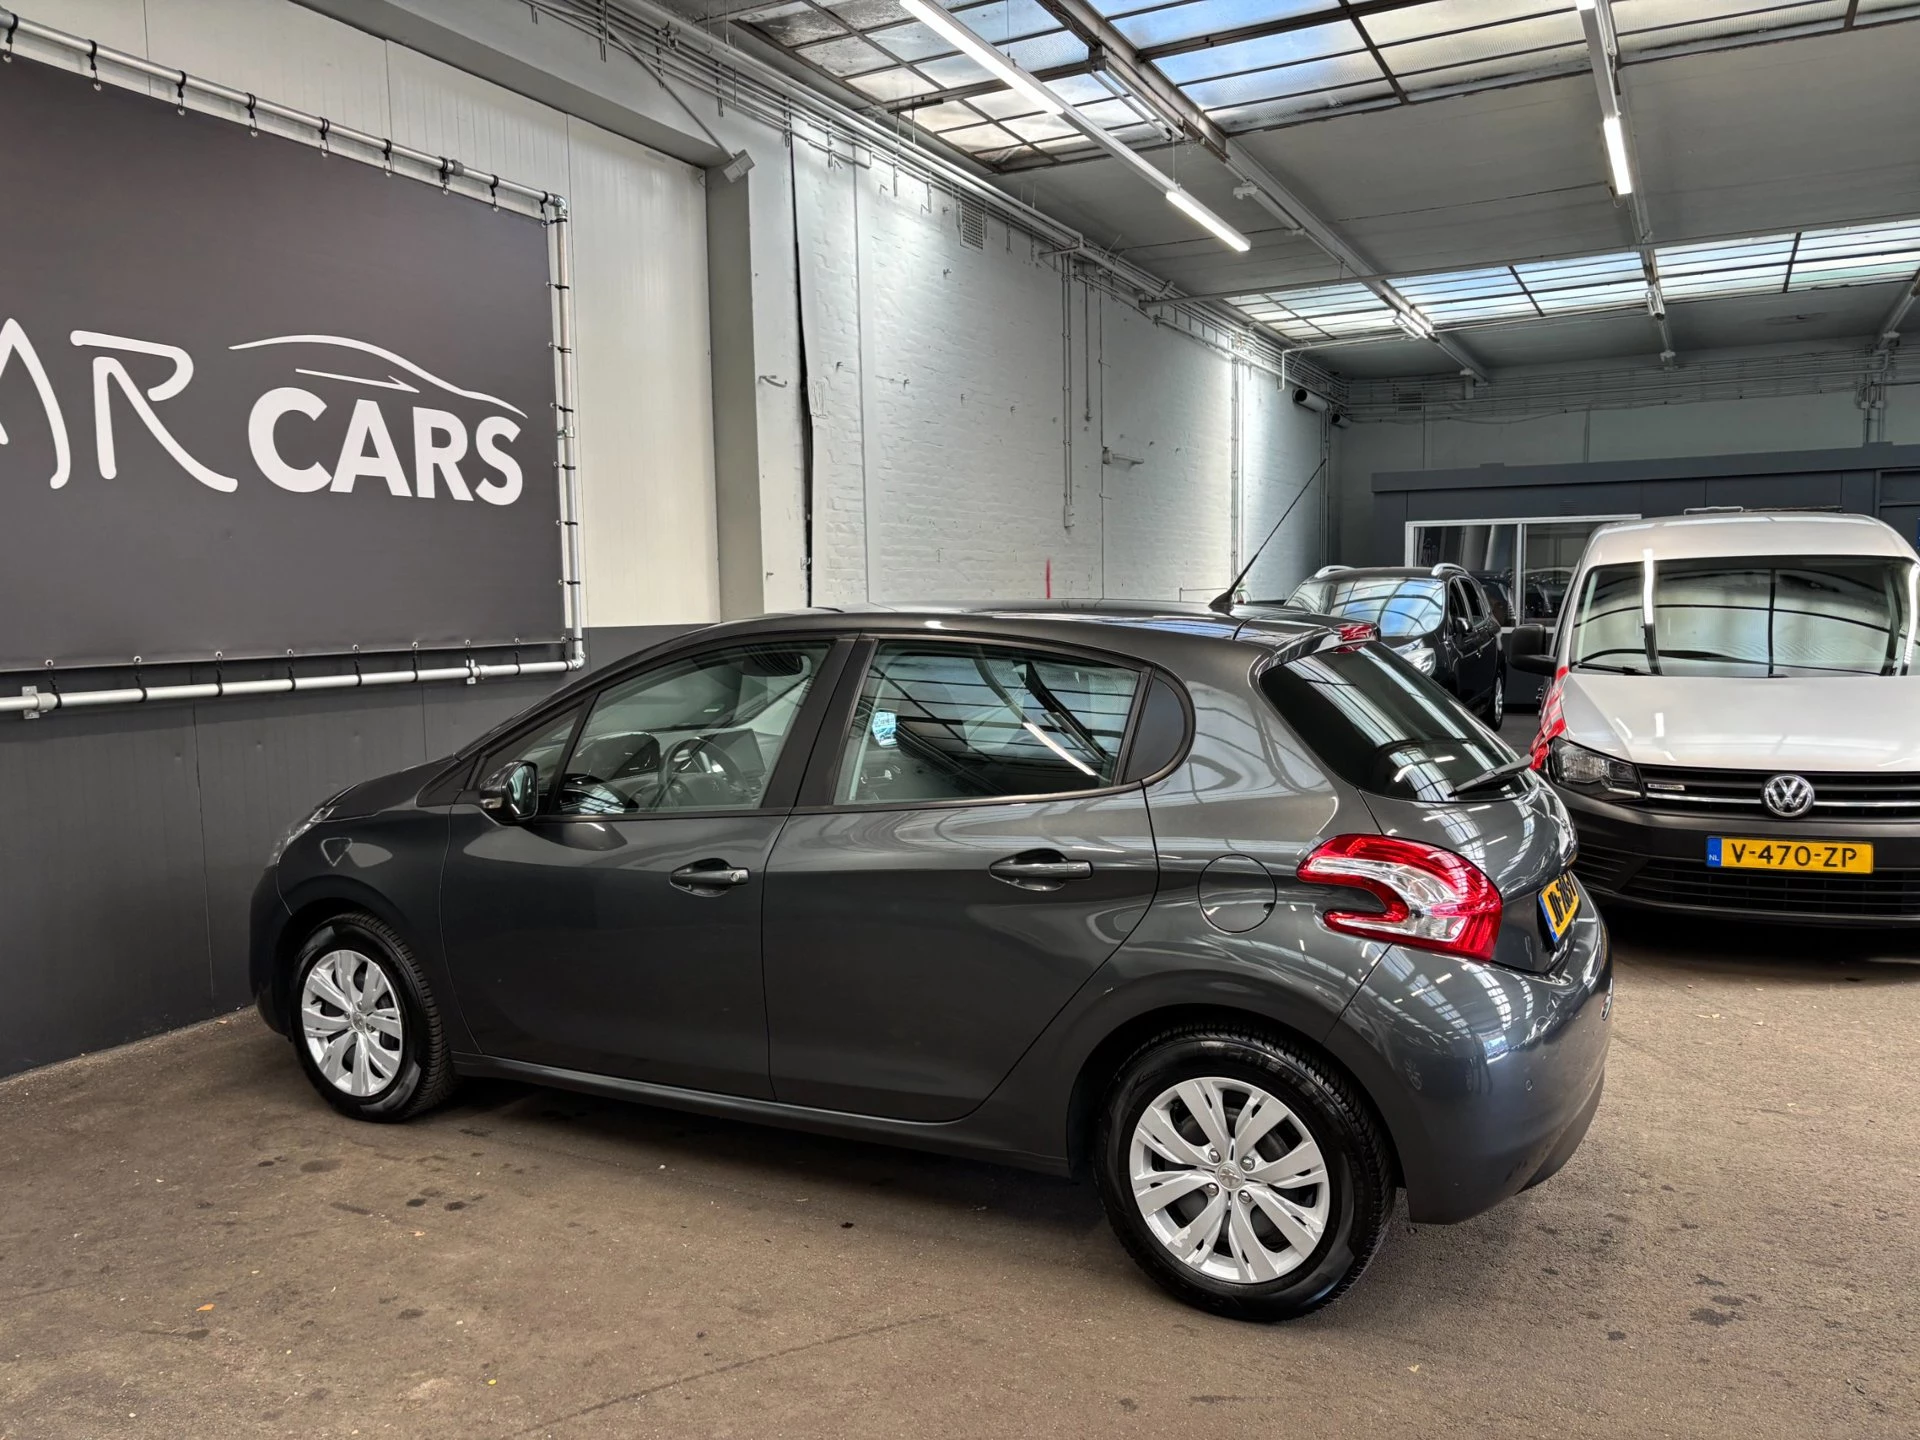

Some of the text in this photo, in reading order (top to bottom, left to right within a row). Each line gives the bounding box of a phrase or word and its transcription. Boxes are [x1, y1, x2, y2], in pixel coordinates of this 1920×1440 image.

[248, 387, 523, 506] CARS
[1708, 843, 1857, 868] NL V-470-ZP
